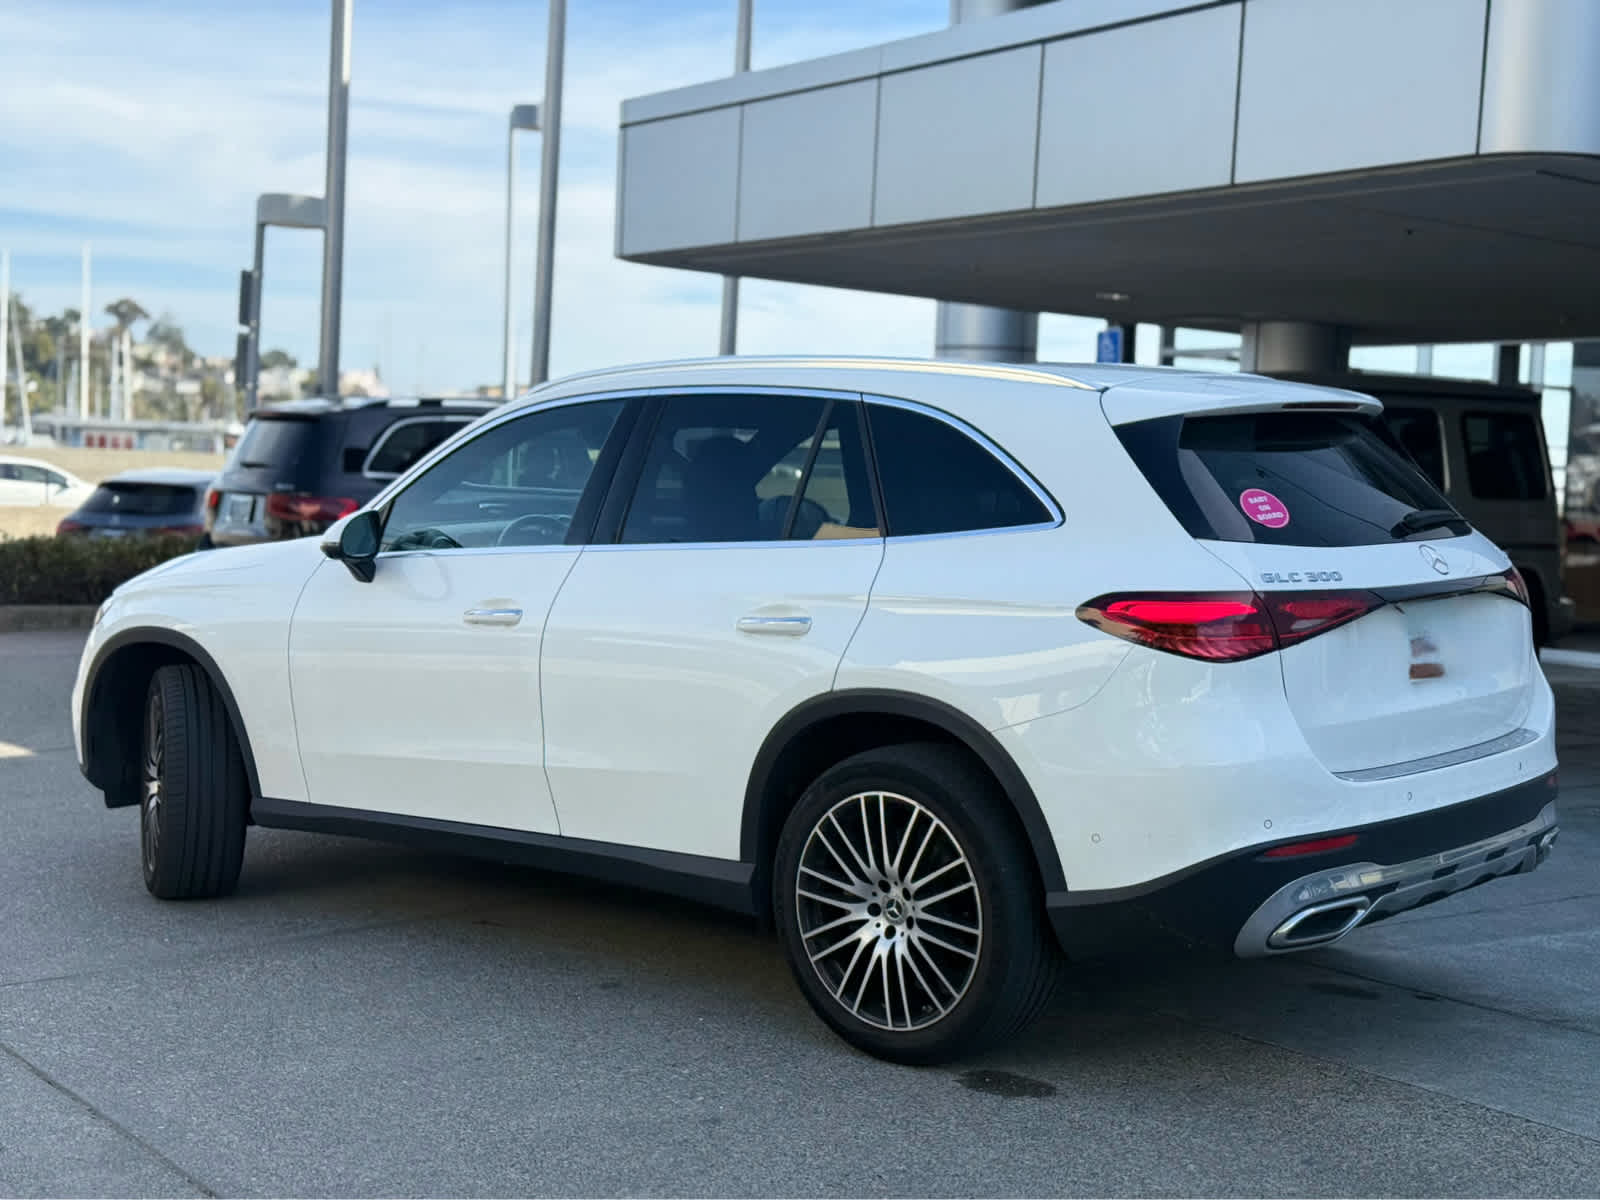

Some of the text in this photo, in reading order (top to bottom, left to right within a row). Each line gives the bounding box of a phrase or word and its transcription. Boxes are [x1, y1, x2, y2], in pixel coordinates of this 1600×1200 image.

[1248, 495, 1267, 504] BABY
[1256, 512, 1284, 520] BOARD
[1261, 571, 1343, 583] GLC 300
